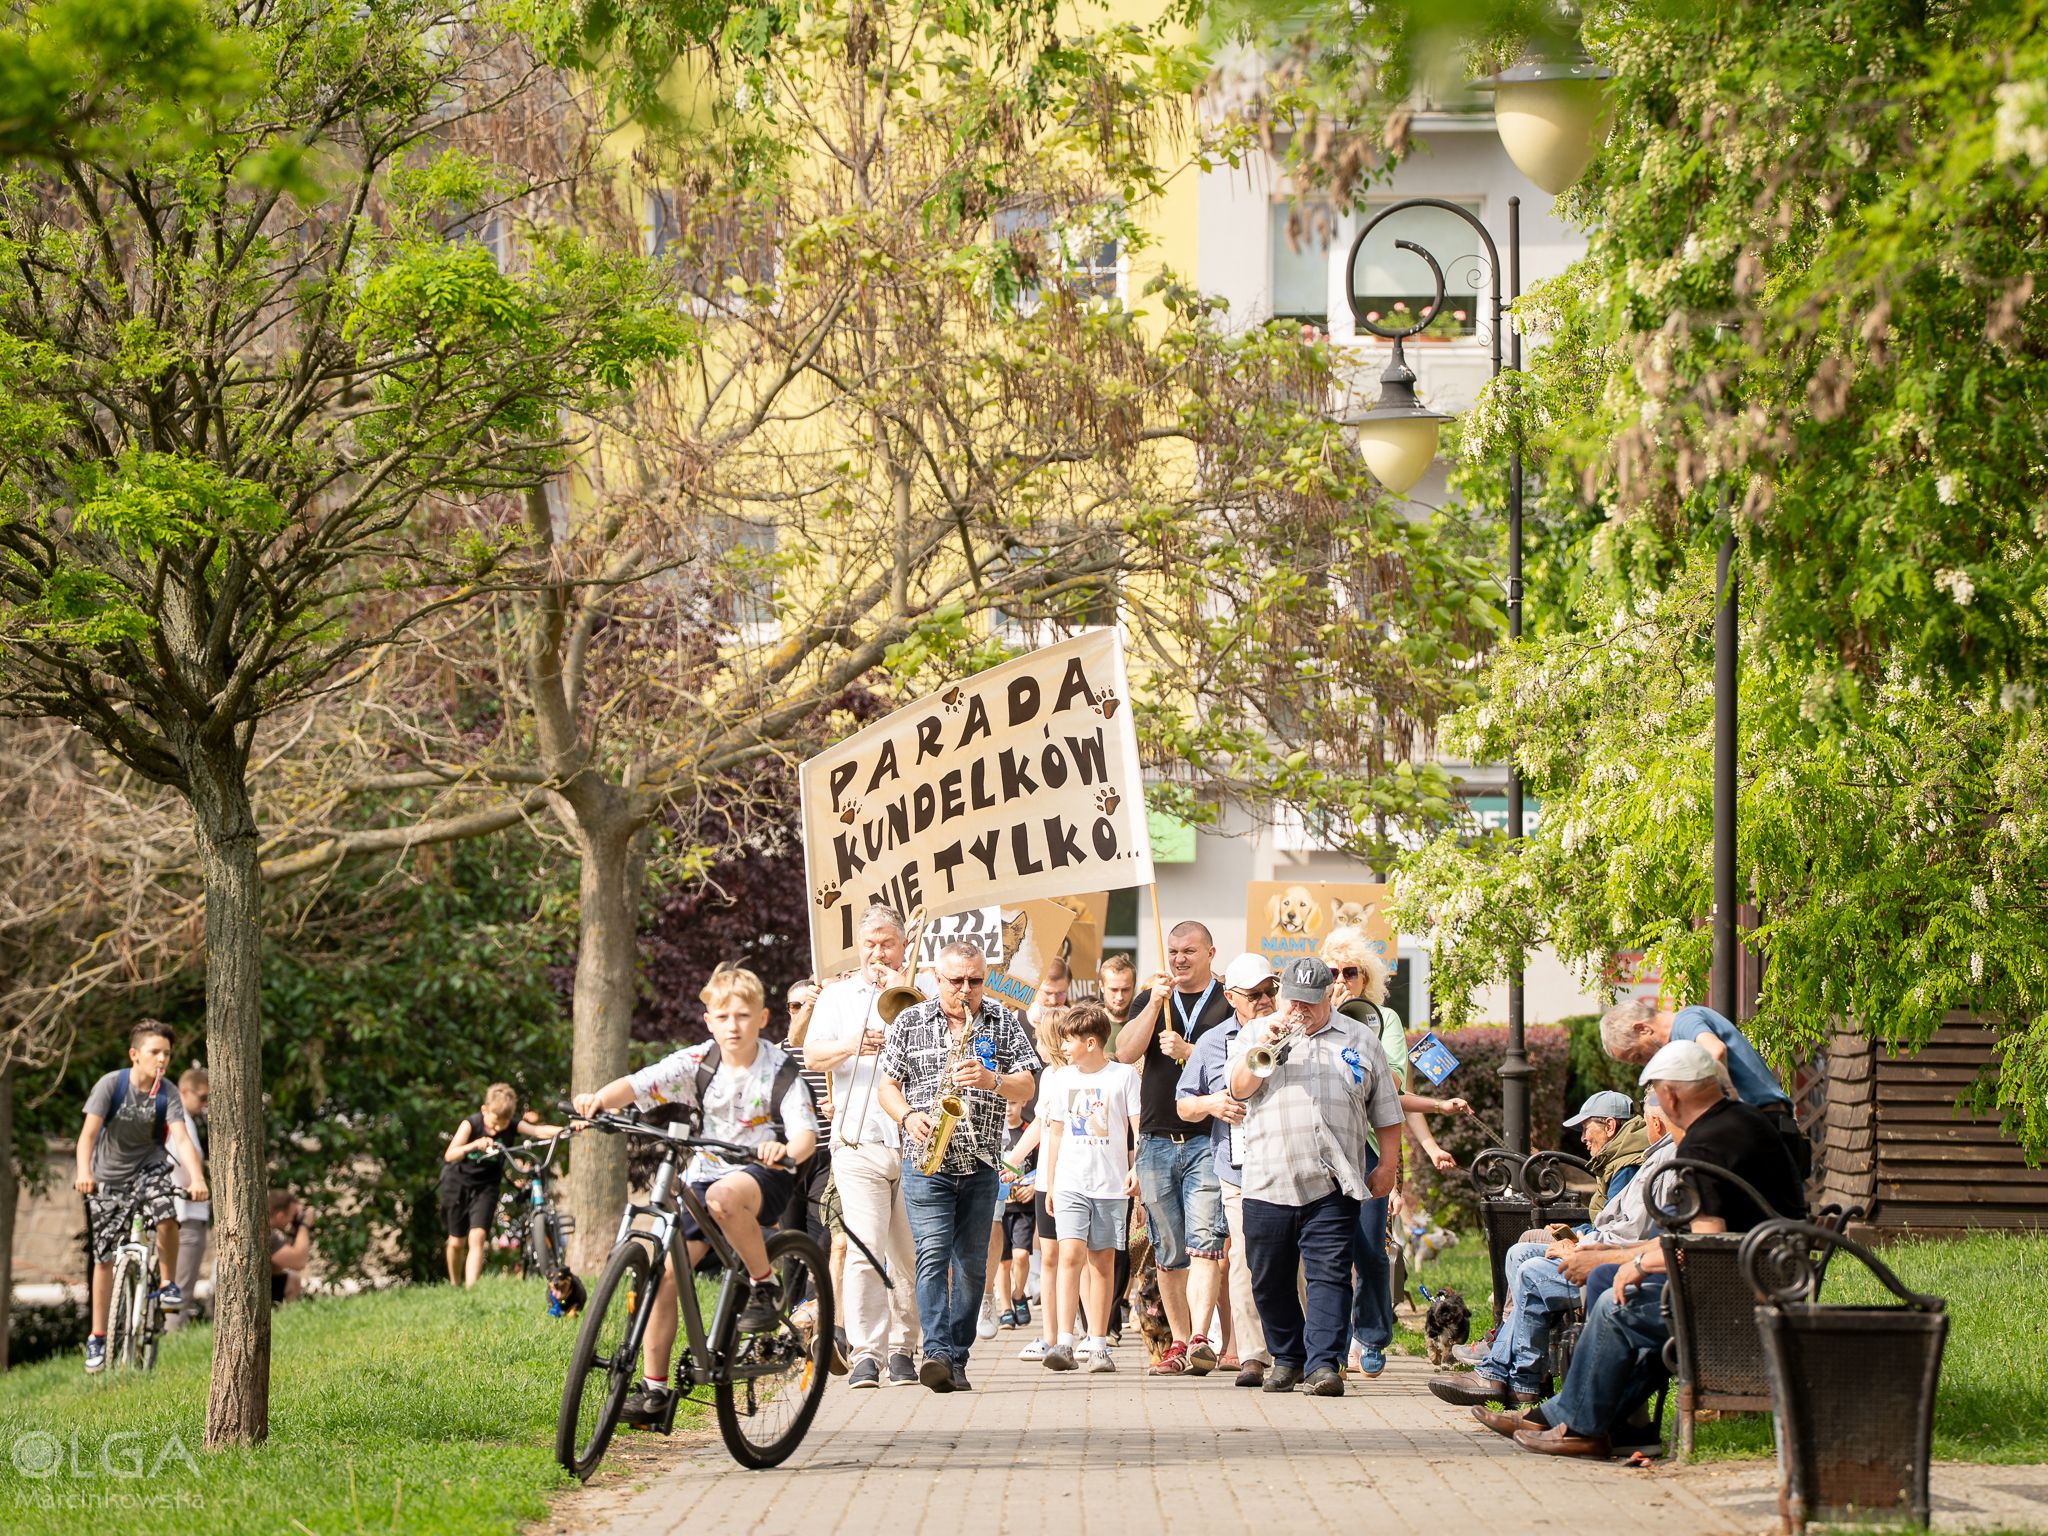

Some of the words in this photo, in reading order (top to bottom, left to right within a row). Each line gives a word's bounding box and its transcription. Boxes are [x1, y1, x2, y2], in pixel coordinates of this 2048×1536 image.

[830, 657, 1099, 813] PARADA
[833, 723, 1109, 887] KUNDELKÓW
[840, 903, 854, 950] I
[1261, 937, 1319, 952] MAMY
[984, 969, 1036, 1006] NAMI
[1296, 969, 1312, 985] M
